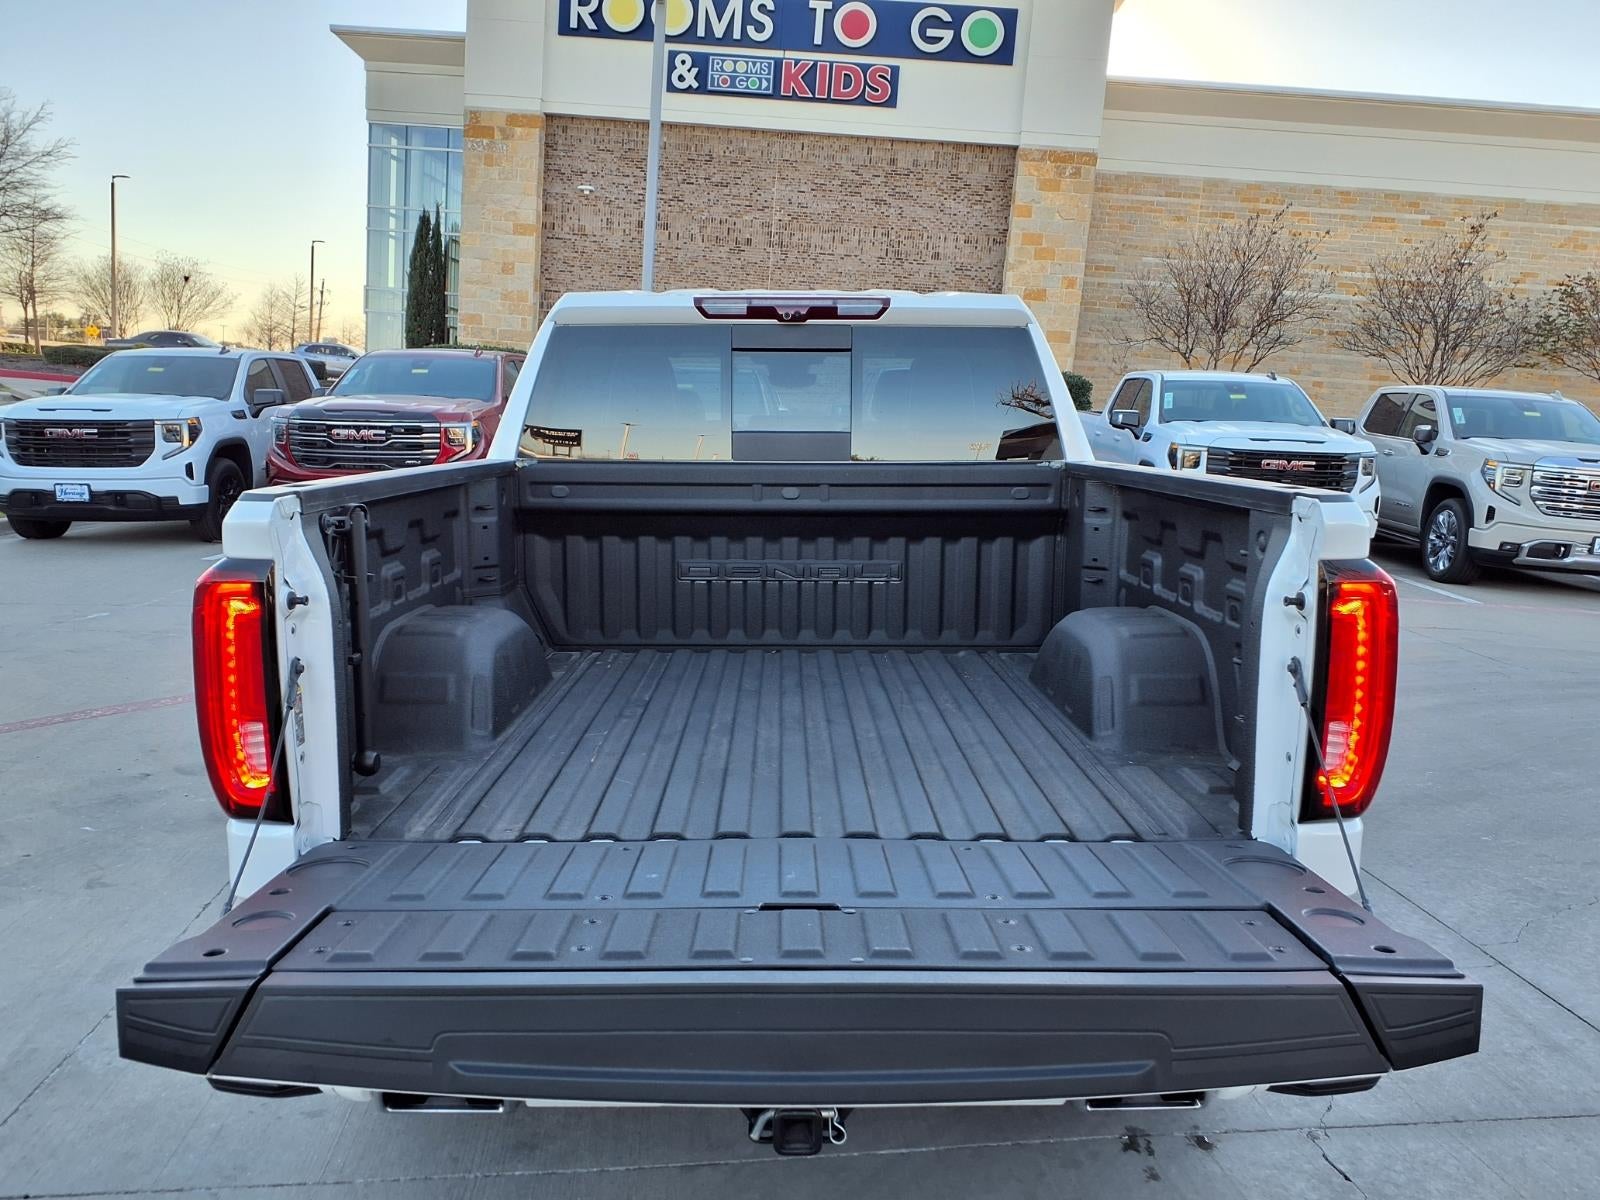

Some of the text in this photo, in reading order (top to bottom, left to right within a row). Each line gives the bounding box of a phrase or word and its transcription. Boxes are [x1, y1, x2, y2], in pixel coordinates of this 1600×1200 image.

[569, 0, 1005, 57] ROOMS TO GO
[671, 53, 699, 89] &
[712, 59, 769, 74] ROOMS
[712, 75, 760, 90] TO GO
[780, 59, 892, 104] KIDS
[44, 428, 98, 439] GMC
[332, 428, 386, 440] GMC
[1261, 459, 1317, 471] GMC
[677, 559, 903, 583] DENALI
